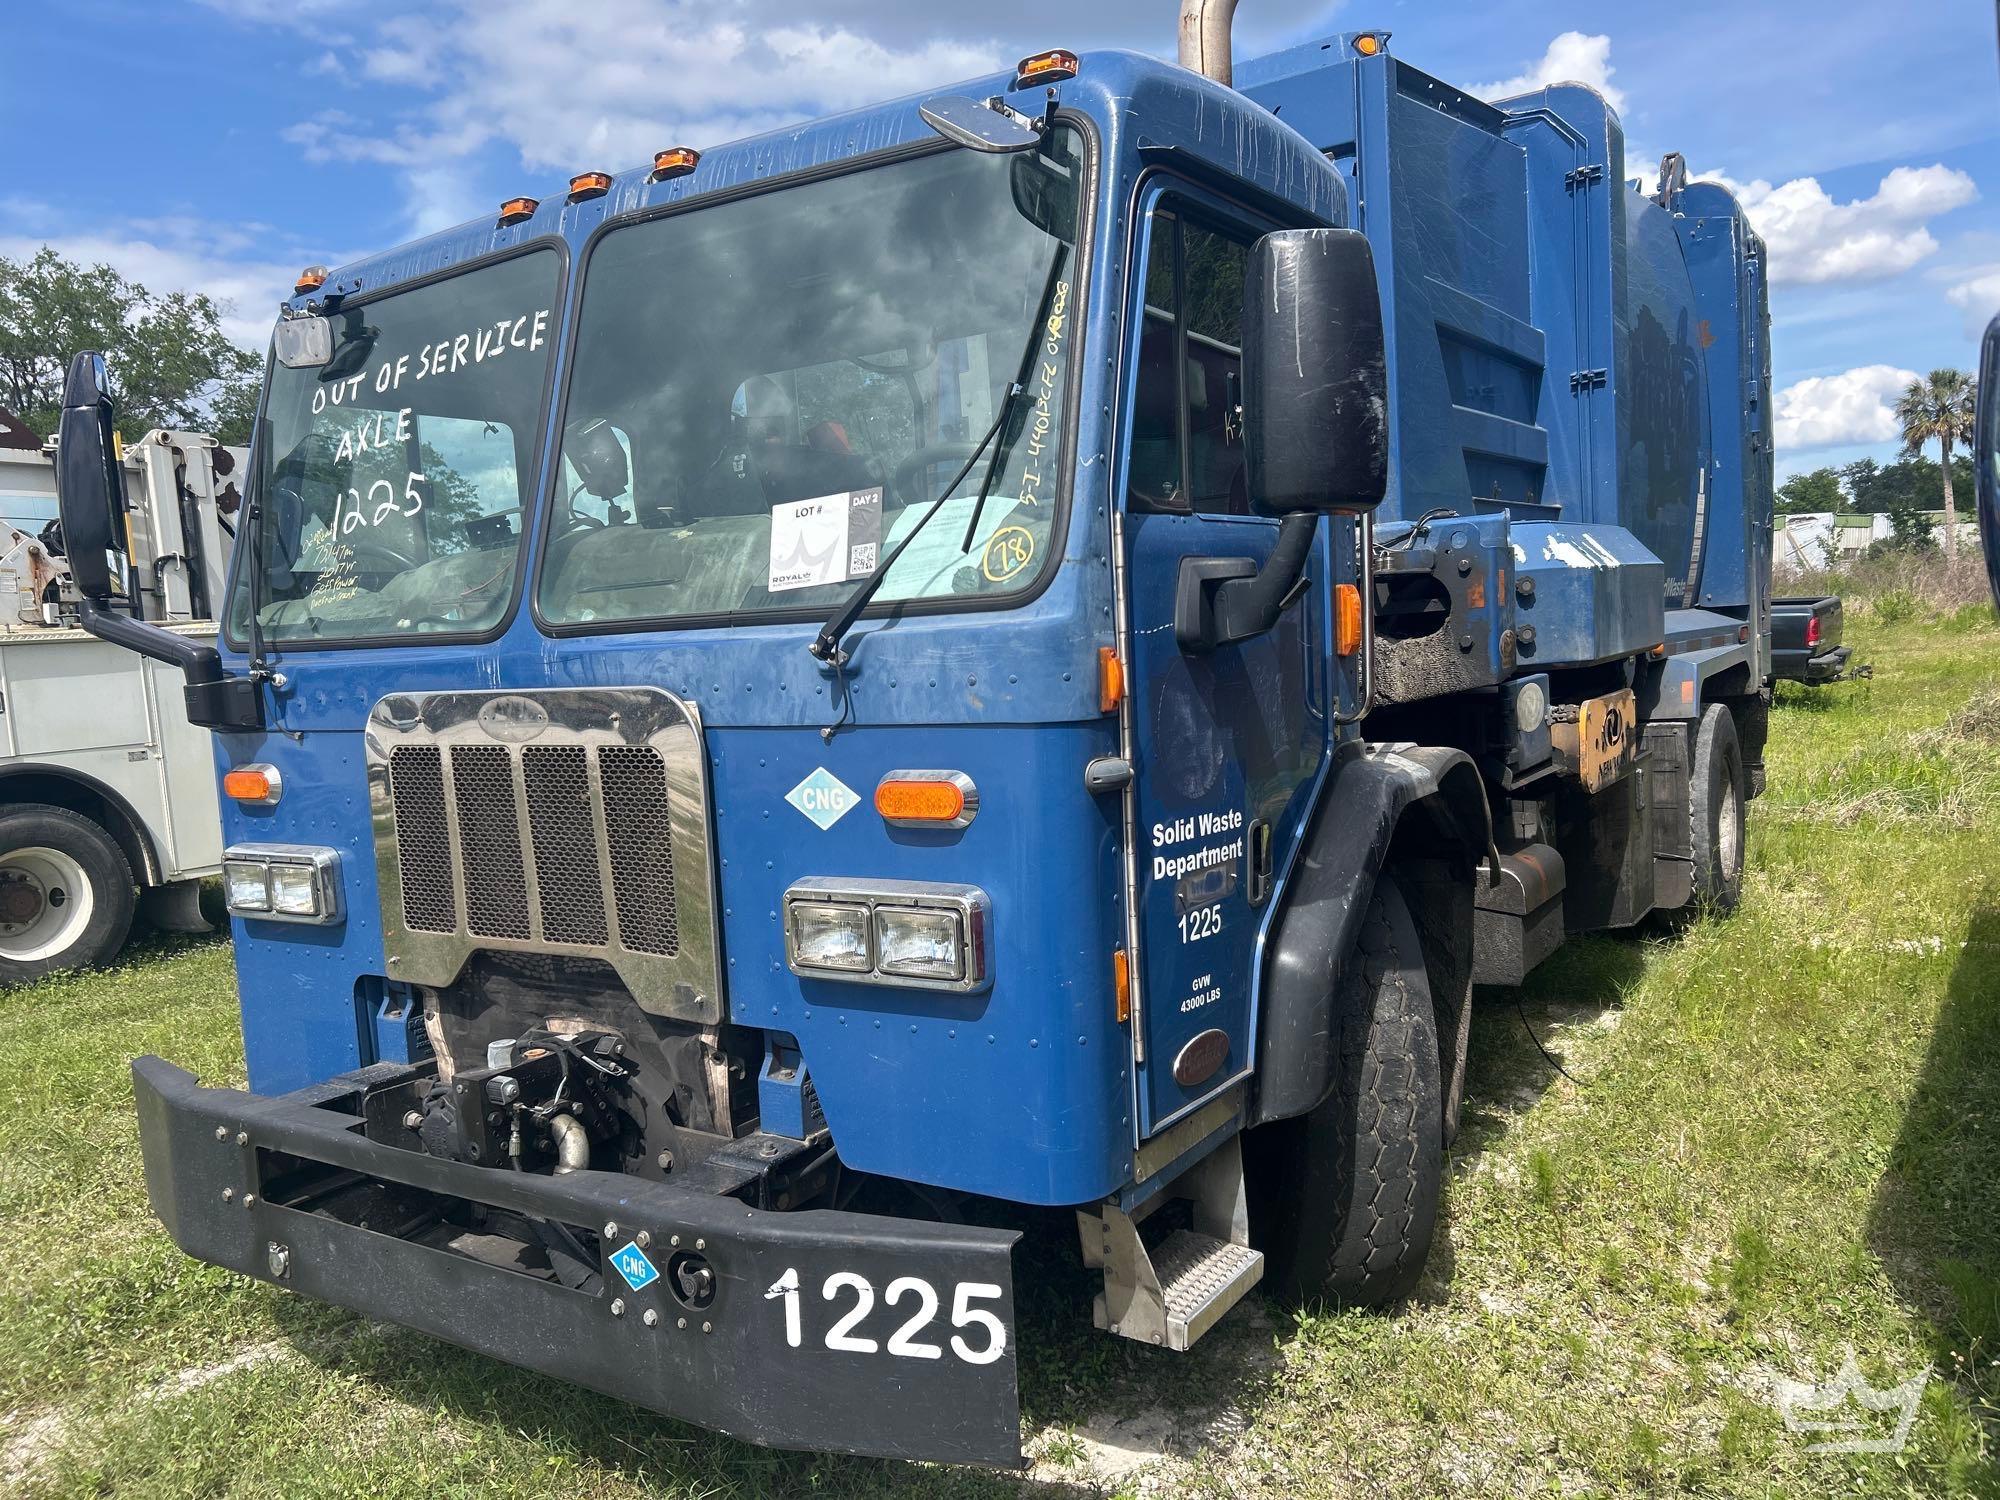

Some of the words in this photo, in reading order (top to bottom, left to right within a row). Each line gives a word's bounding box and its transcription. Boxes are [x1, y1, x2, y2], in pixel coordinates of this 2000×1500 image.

[312, 372, 367, 414] OUT
[375, 355, 409, 392] OF
[416, 310, 549, 379] SERVICE
[333, 408, 412, 465] AXLE
[332, 472, 425, 541] 1225
[796, 507, 815, 518] LOT
[817, 505, 823, 515] #
[853, 495, 871, 507] DAY
[872, 494, 878, 503] 2
[773, 574, 802, 583] ROYAL
[803, 788, 845, 810] CNG
[1153, 816, 1195, 847] Solid
[1199, 809, 1242, 838] Waste
[1154, 837, 1242, 880] Department
[1178, 904, 1221, 945] 1225
[1192, 974, 1210, 991] GVW
[1181, 994, 1205, 1012] 43000
[1206, 987, 1220, 1003] LBS
[622, 1254, 646, 1279] CNG
[764, 1267, 1006, 1364] 1225
